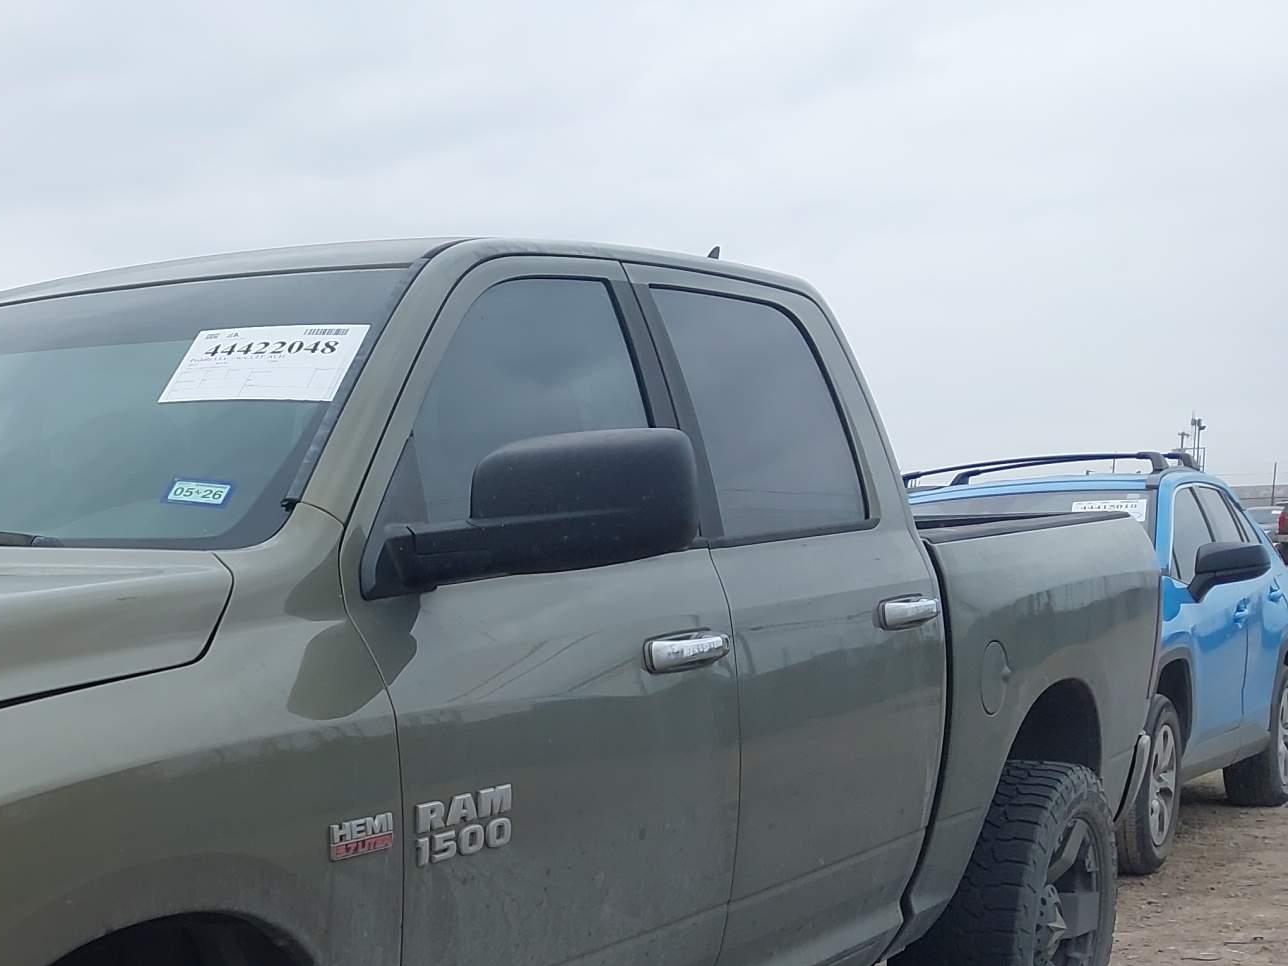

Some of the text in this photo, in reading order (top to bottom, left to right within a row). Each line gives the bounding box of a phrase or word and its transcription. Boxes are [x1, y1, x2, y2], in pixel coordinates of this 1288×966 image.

[204, 340, 340, 357] 44422048
[173, 486, 224, 500] 05 26
[416, 784, 512, 834] RAM
[329, 812, 394, 843] HEMI
[416, 817, 512, 867] 1500
